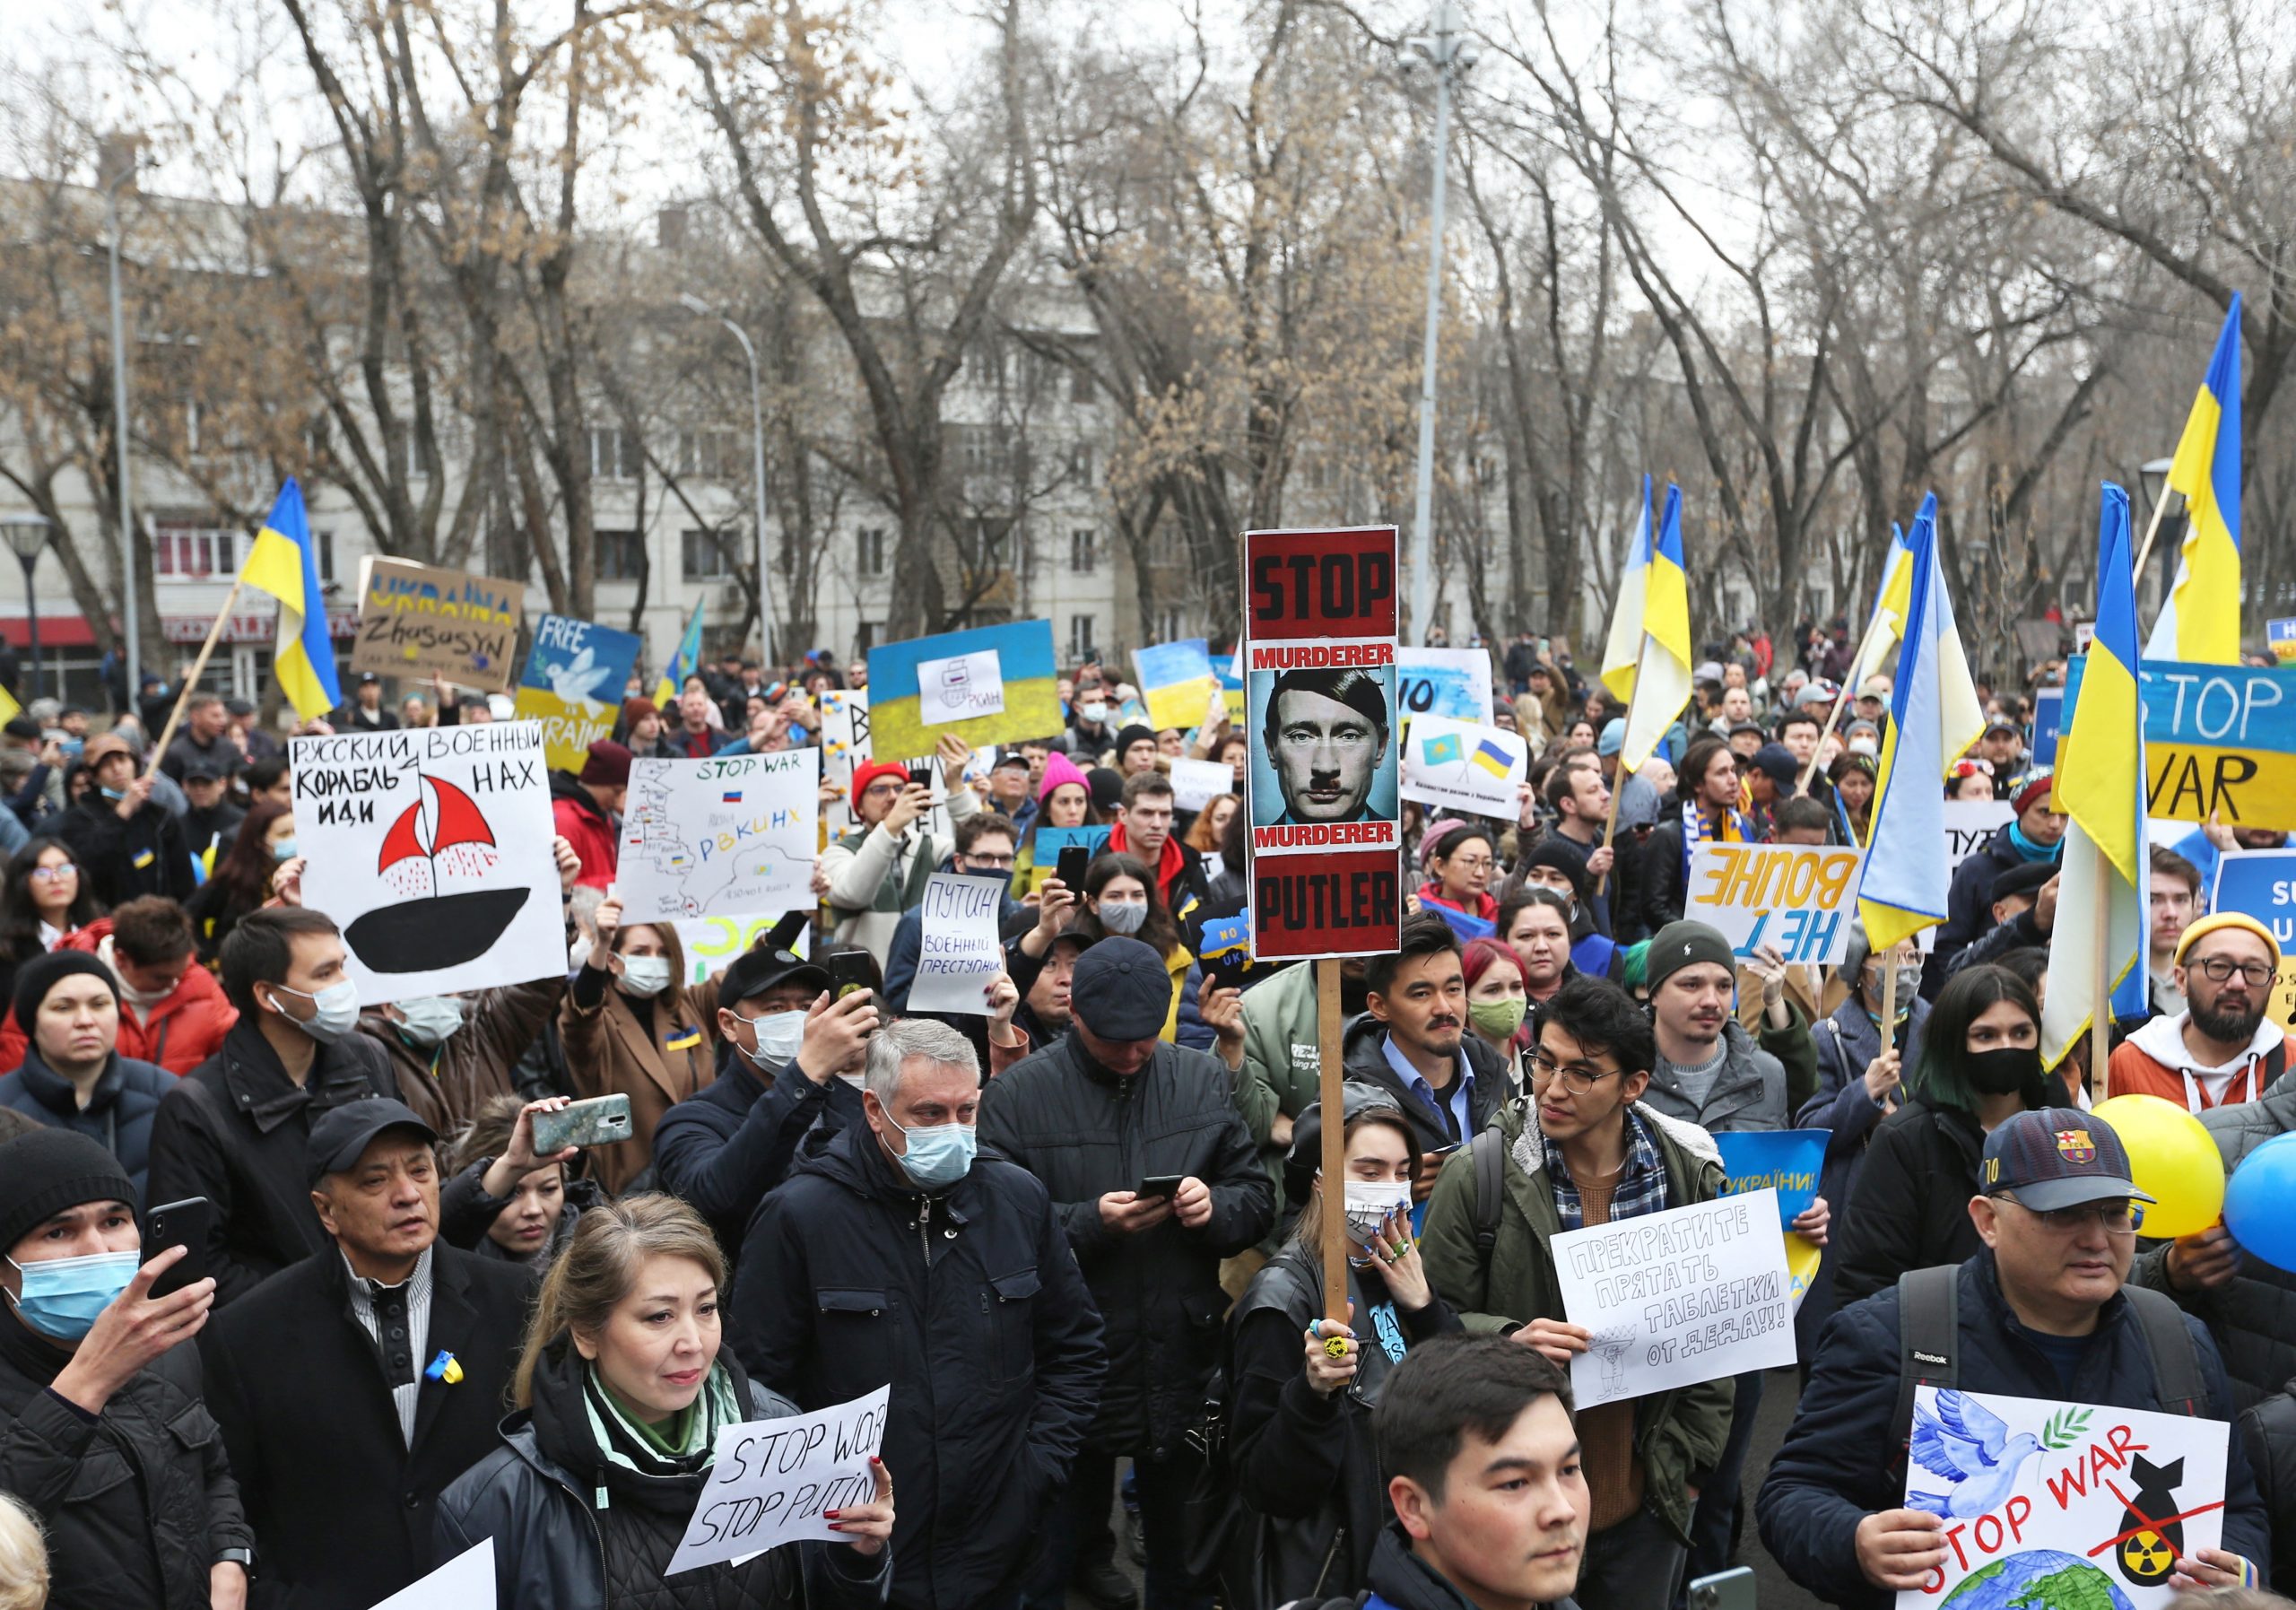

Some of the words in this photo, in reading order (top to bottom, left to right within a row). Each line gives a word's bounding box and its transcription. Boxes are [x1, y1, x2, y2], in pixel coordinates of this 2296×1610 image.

[370, 573, 512, 627] UKRAINA
[1254, 552, 1390, 621] STOP
[539, 615, 591, 655] FREE
[1253, 643, 1394, 669] MURDERER
[292, 732, 409, 764] РУССКИЙ
[427, 720, 540, 760] ВОЕННЫЙ
[296, 765, 400, 799] КОРАБЛЬ
[696, 758, 756, 780] STOP
[764, 753, 801, 773] WAR
[317, 799, 374, 827] ИДИ
[1255, 822, 1393, 848] MURDERER
[926, 881, 996, 919] ПУТИН
[1257, 871, 1396, 932] PUTLER
[924, 934, 988, 953] ВОЕННЫЙ
[1219, 927, 1238, 941] NO
[1732, 909, 1844, 962] НЕТ
[920, 959, 1002, 974] ПРЕСТУПНИК
[1985, 1157, 1999, 1185] 10
[1568, 1205, 1749, 1279] ПРЕКРАТИТЕ
[1595, 1254, 1718, 1309] ПРЯТАТЬ
[1644, 1270, 1779, 1334] ТАБЛЕТКИ
[1647, 1337, 1677, 1367] ОТ
[1681, 1302, 1786, 1358] ДЕДА!!!
[1914, 1351, 1947, 1364] Reebok
[719, 1423, 827, 1484] STOP
[2047, 1425, 2149, 1510] WAR
[689, 1491, 785, 1547] STOP
